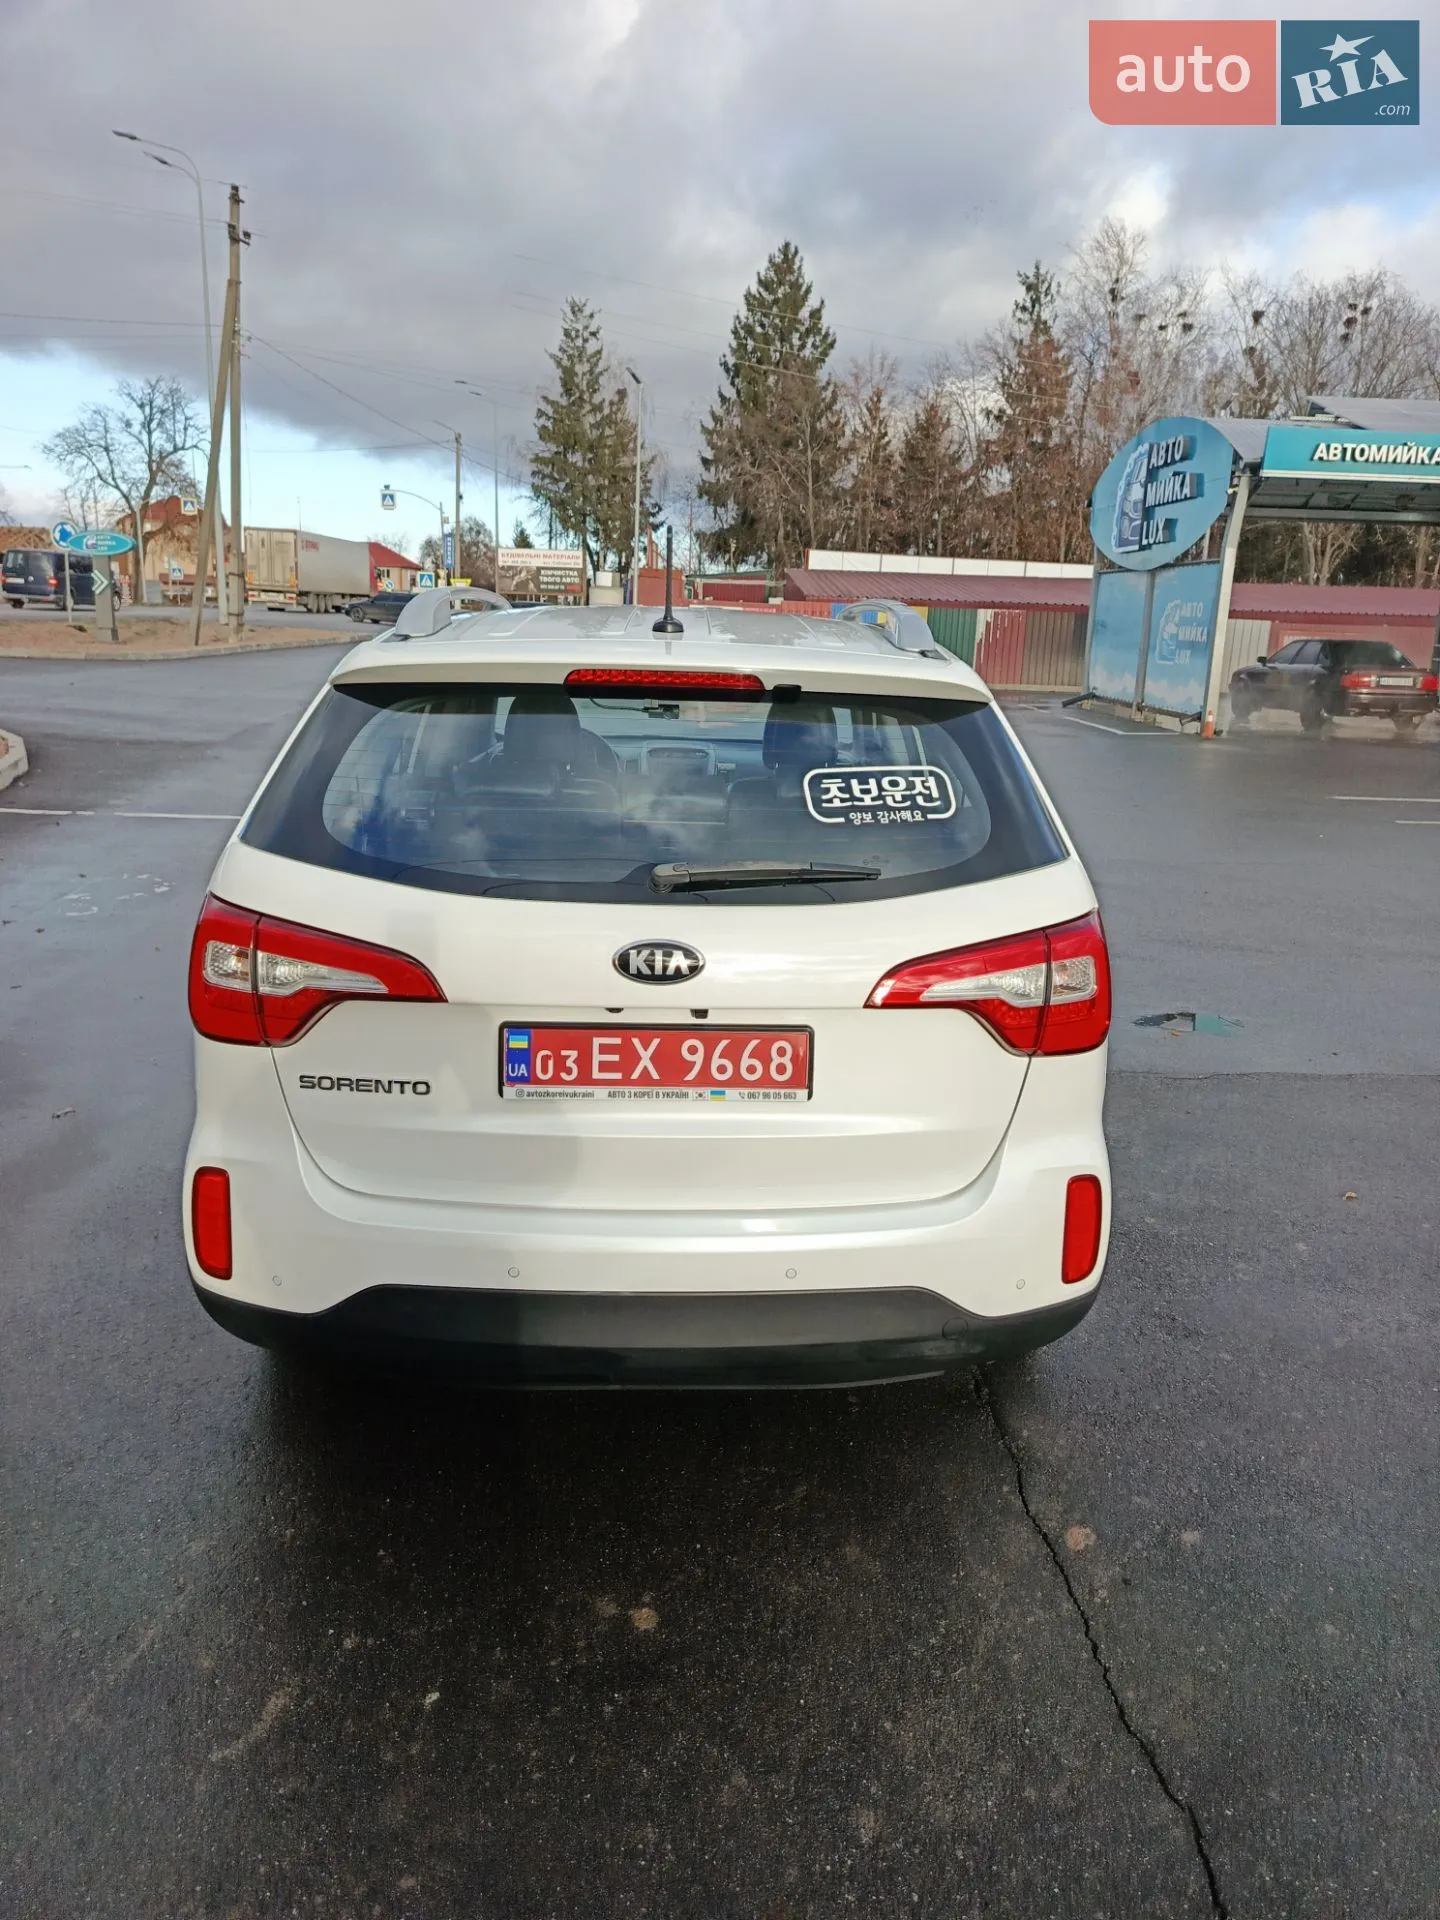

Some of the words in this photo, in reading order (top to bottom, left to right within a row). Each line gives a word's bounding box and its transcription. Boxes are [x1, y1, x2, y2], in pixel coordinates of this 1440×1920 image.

[1149, 435, 1184, 469] АВТО
[1145, 474, 1192, 509] МИЙКА
[1141, 518, 1166, 546] LUX
[1181, 601, 1204, 617] АВТО
[1178, 626, 1208, 642] МИЙКА
[1175, 647, 1191, 665] LUX
[820, 776, 942, 807] 초보운전
[849, 811, 875, 825] 양보
[877, 810, 924, 824] 감사해요
[629, 949, 690, 975] KIA
[535, 1050, 579, 1081] 03
[680, 1038, 793, 1082] 9668
[508, 1063, 528, 1077] UA
[299, 1074, 431, 1096] SORENTO
[526, 1089, 595, 1099] avtozkoreivukraini
[607, 1090, 626, 1099] АВТО
[633, 1089, 654, 1099] КОРЕЇ
[662, 1089, 689, 1099] УКРАЇНІ
[747, 1091, 761, 1100] 067
